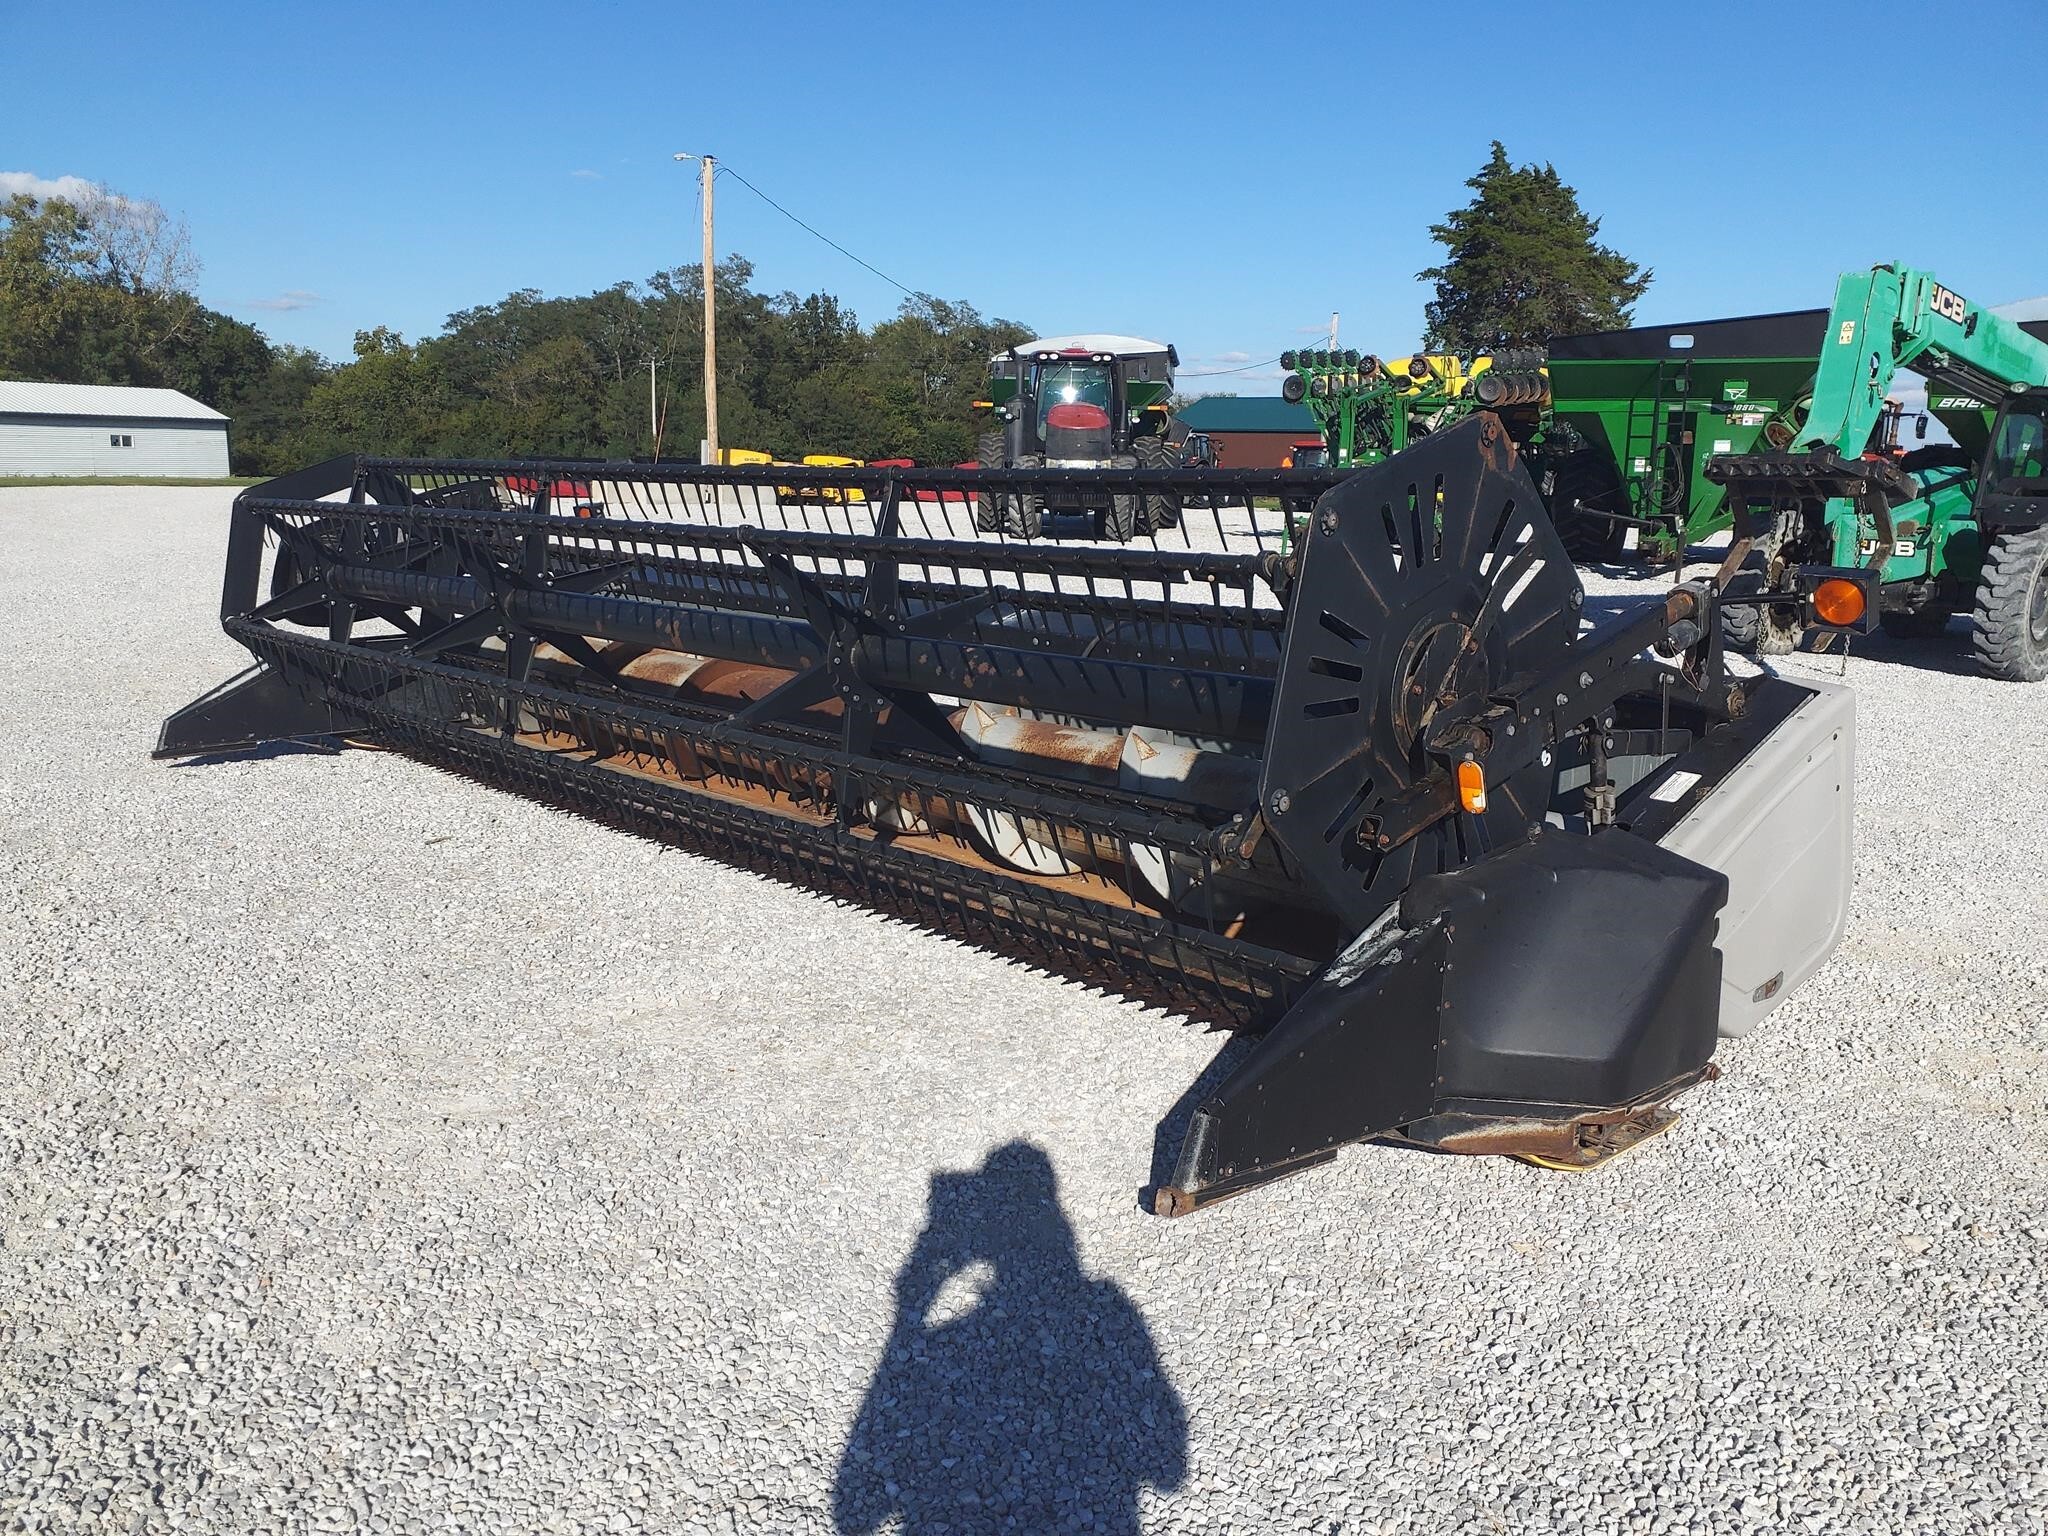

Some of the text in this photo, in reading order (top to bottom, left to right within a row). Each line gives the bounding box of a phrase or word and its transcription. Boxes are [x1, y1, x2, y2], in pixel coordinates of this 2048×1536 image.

[1930, 284, 1965, 323] JCB
[1938, 398, 1985, 408] BRE
[1860, 540, 1915, 557] JB
